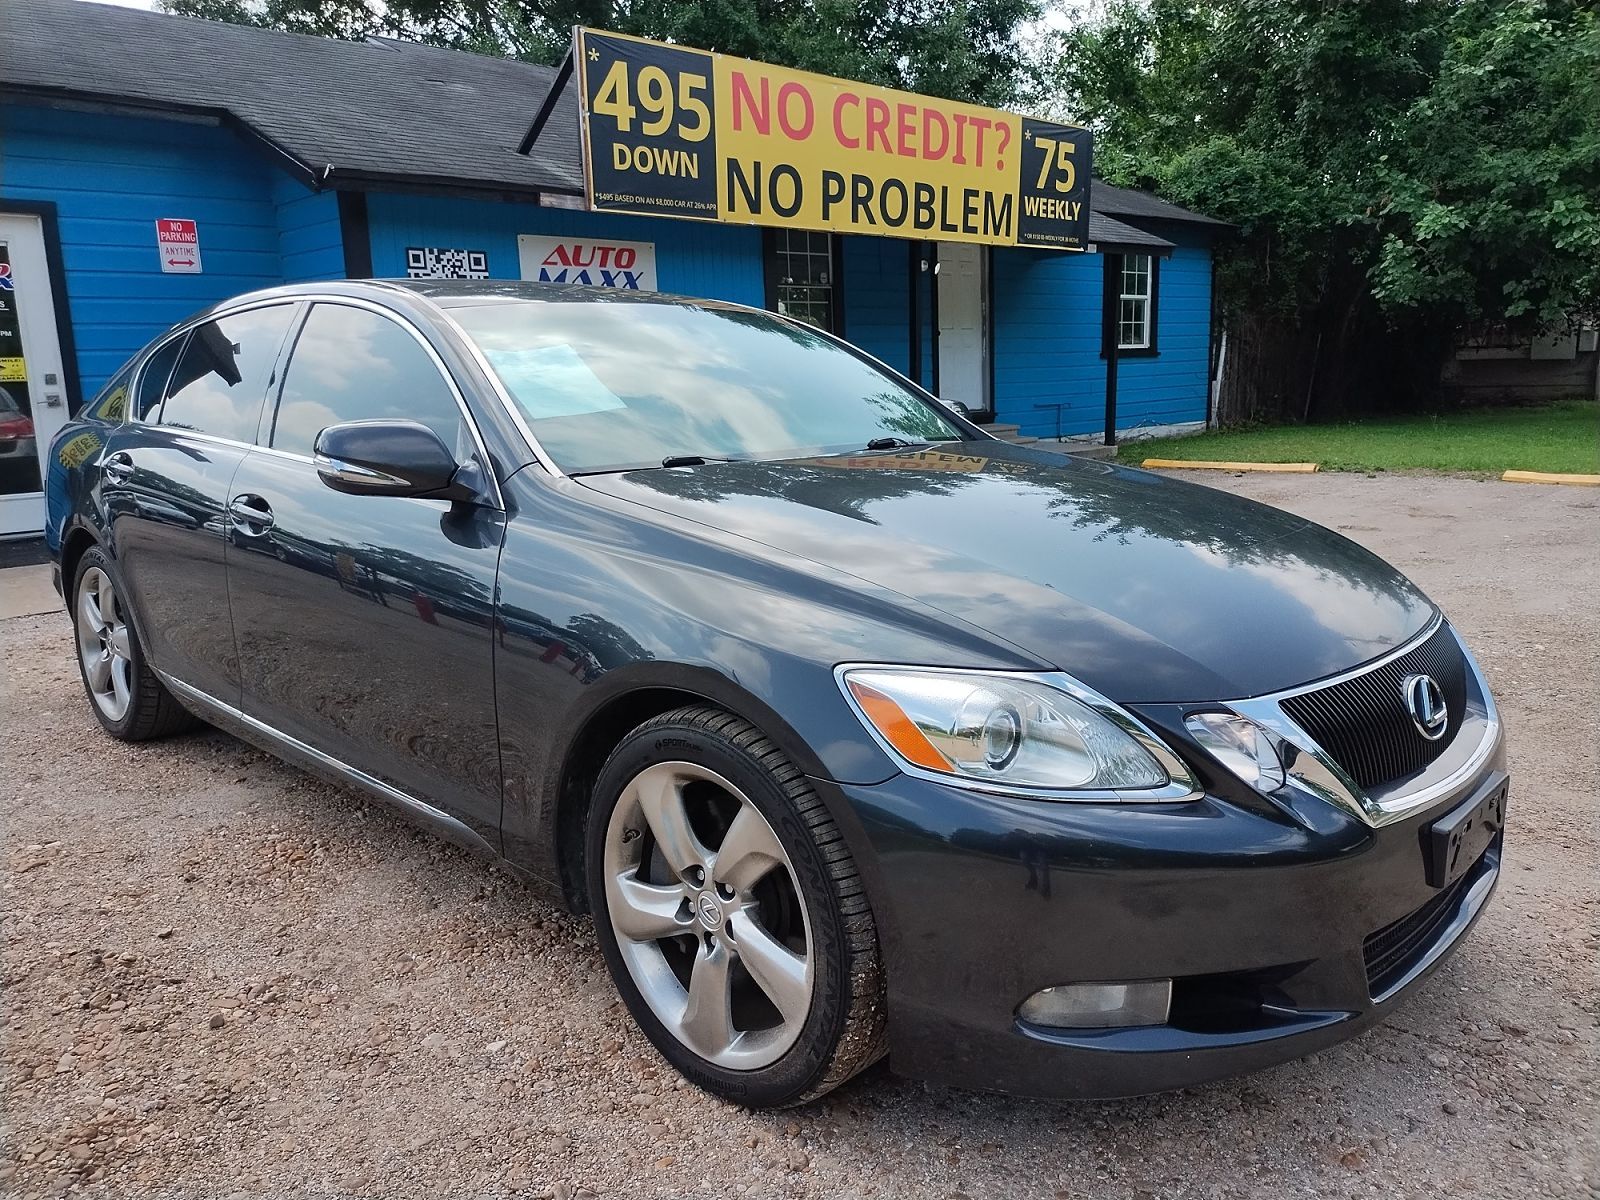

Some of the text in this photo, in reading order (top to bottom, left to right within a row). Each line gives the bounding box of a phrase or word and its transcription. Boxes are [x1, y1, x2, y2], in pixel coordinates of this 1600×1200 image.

[731, 71, 1011, 172] NO CREDIT?
[612, 143, 699, 179] DOWN
[614, 194, 634, 203] BASED
[635, 196, 645, 204] ON
[646, 197, 655, 205] AN
[674, 200, 686, 208] CAR
[726, 157, 1013, 237] NO PROBLEM
[1024, 196, 1082, 222] WEEKLY
[160, 231, 196, 242] PARKING
[170, 222, 182, 232] NO
[165, 247, 196, 256] ANYTIME
[541, 244, 637, 269] AUTO
